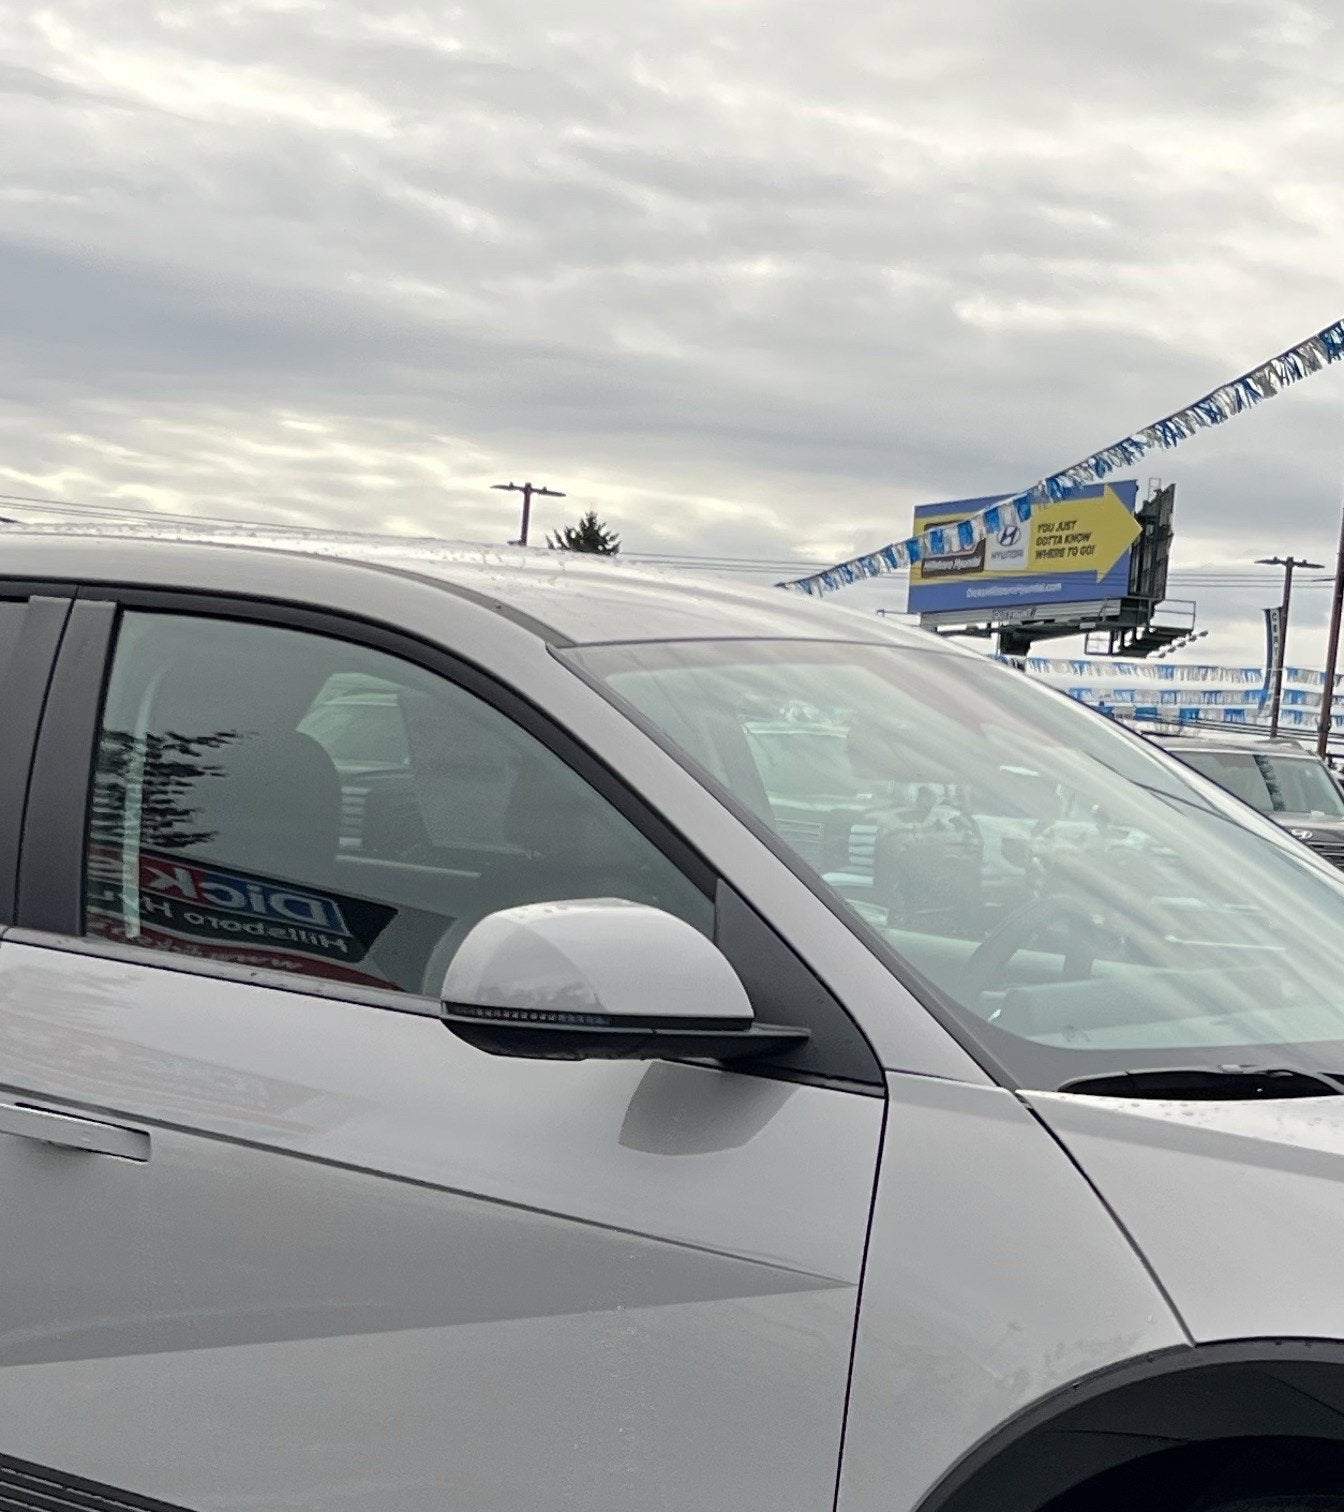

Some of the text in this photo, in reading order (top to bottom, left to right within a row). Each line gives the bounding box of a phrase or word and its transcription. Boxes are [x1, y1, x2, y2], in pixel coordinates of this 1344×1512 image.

[1037, 520, 1077, 533] YOU JUST
[1036, 532, 1092, 546] GOTTA KNOW
[991, 549, 1024, 560] HYUNDAI
[1035, 548, 1066, 560] WHERE
[1067, 546, 1079, 557] TO
